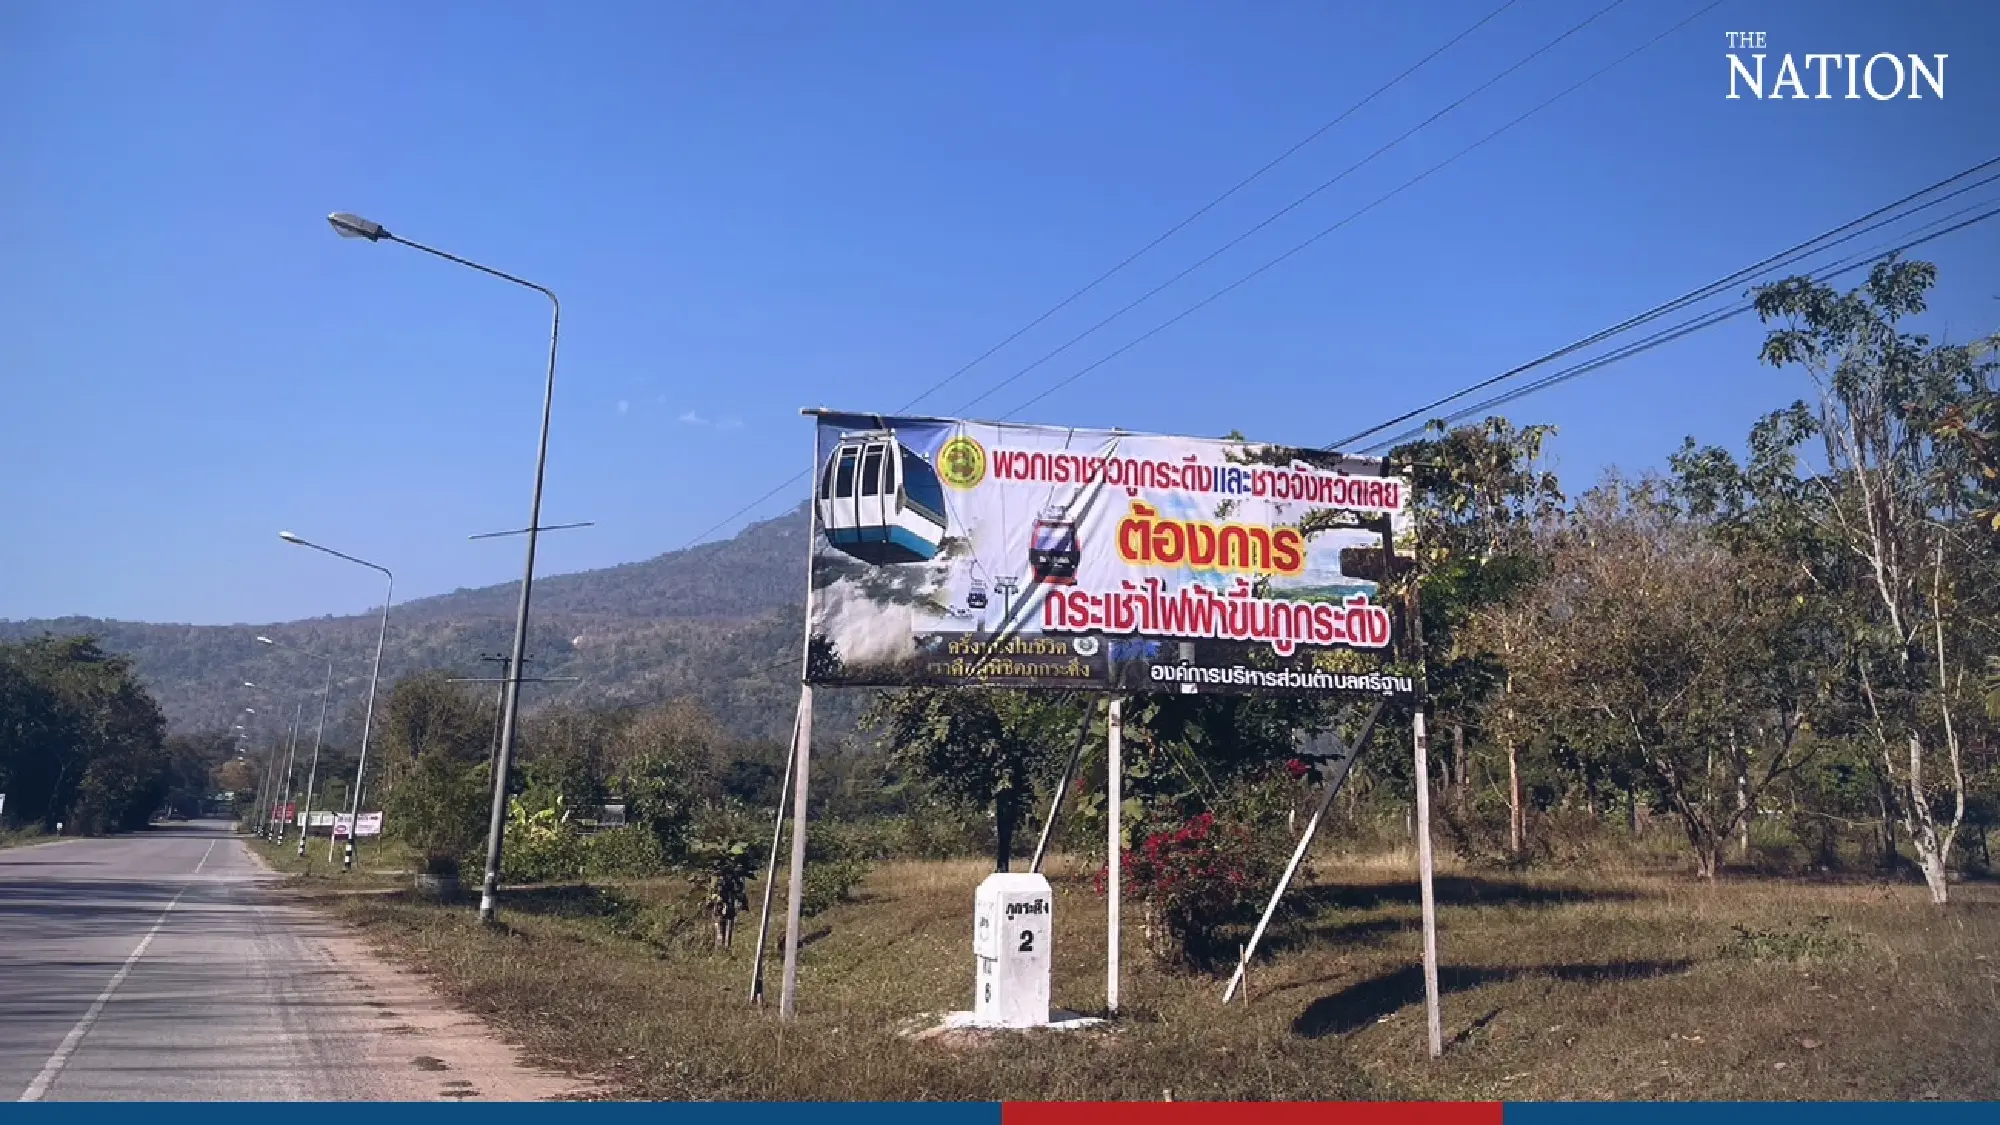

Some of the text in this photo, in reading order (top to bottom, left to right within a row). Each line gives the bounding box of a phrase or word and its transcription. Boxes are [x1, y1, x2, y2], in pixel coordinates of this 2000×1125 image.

[1118, 502, 1302, 572] ต้องการ
[1044, 576, 1390, 652] กระเช้าไฟฟ้าขึ้นภูกระดึง
[1150, 661, 1413, 697] องค์การบริหารส่วนตำบลศรีฐาน
[1018, 929, 1035, 952] 2
